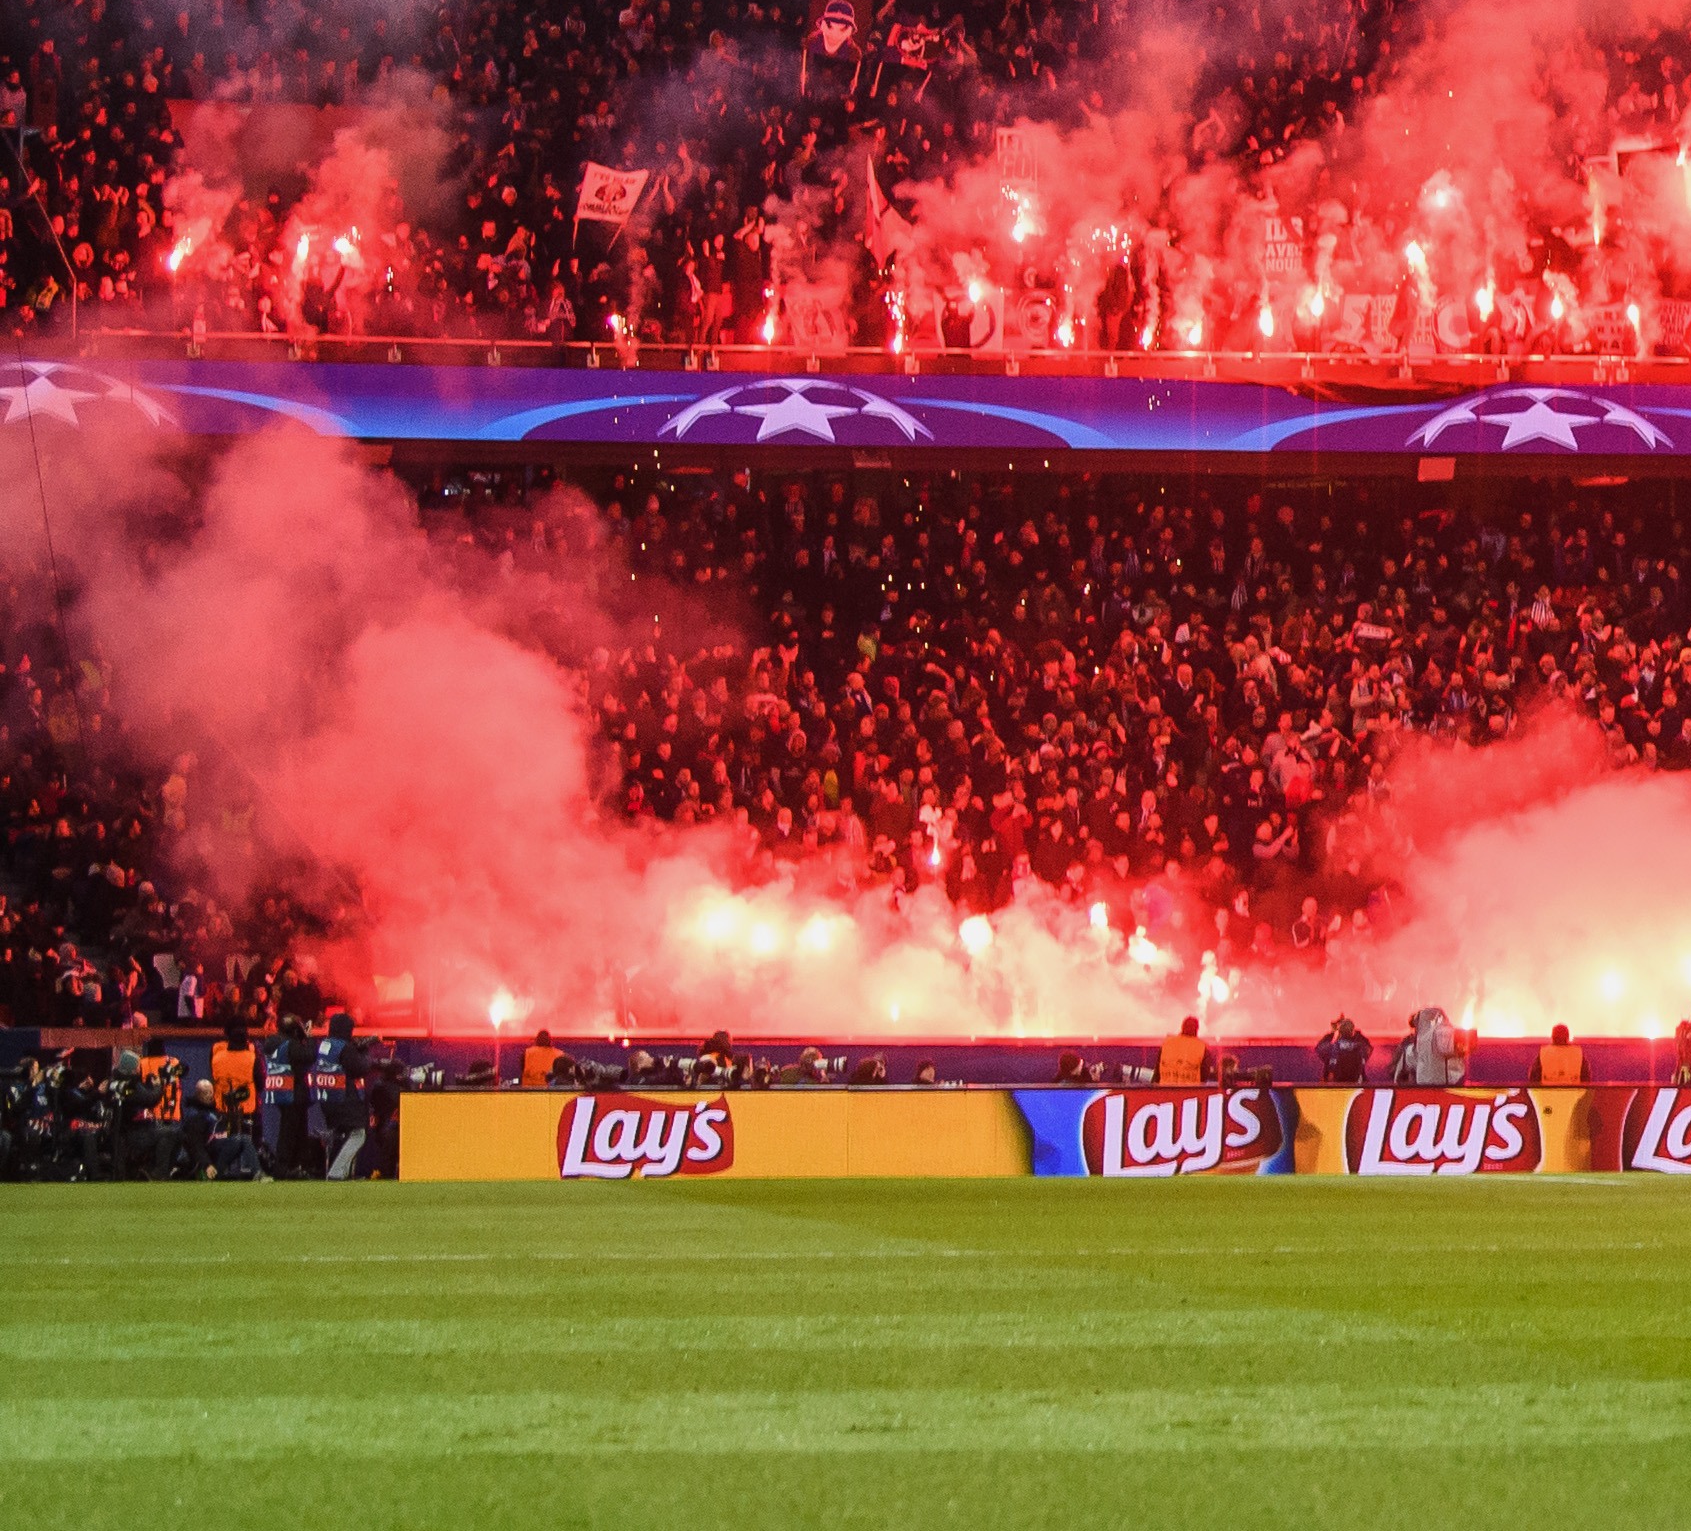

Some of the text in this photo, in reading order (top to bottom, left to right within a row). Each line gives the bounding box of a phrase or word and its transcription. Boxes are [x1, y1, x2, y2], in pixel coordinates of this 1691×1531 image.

[562, 1096, 726, 1177] Lay's
[1103, 1088, 1260, 1177] Lay's
[1358, 1089, 1528, 1175] Lay's
